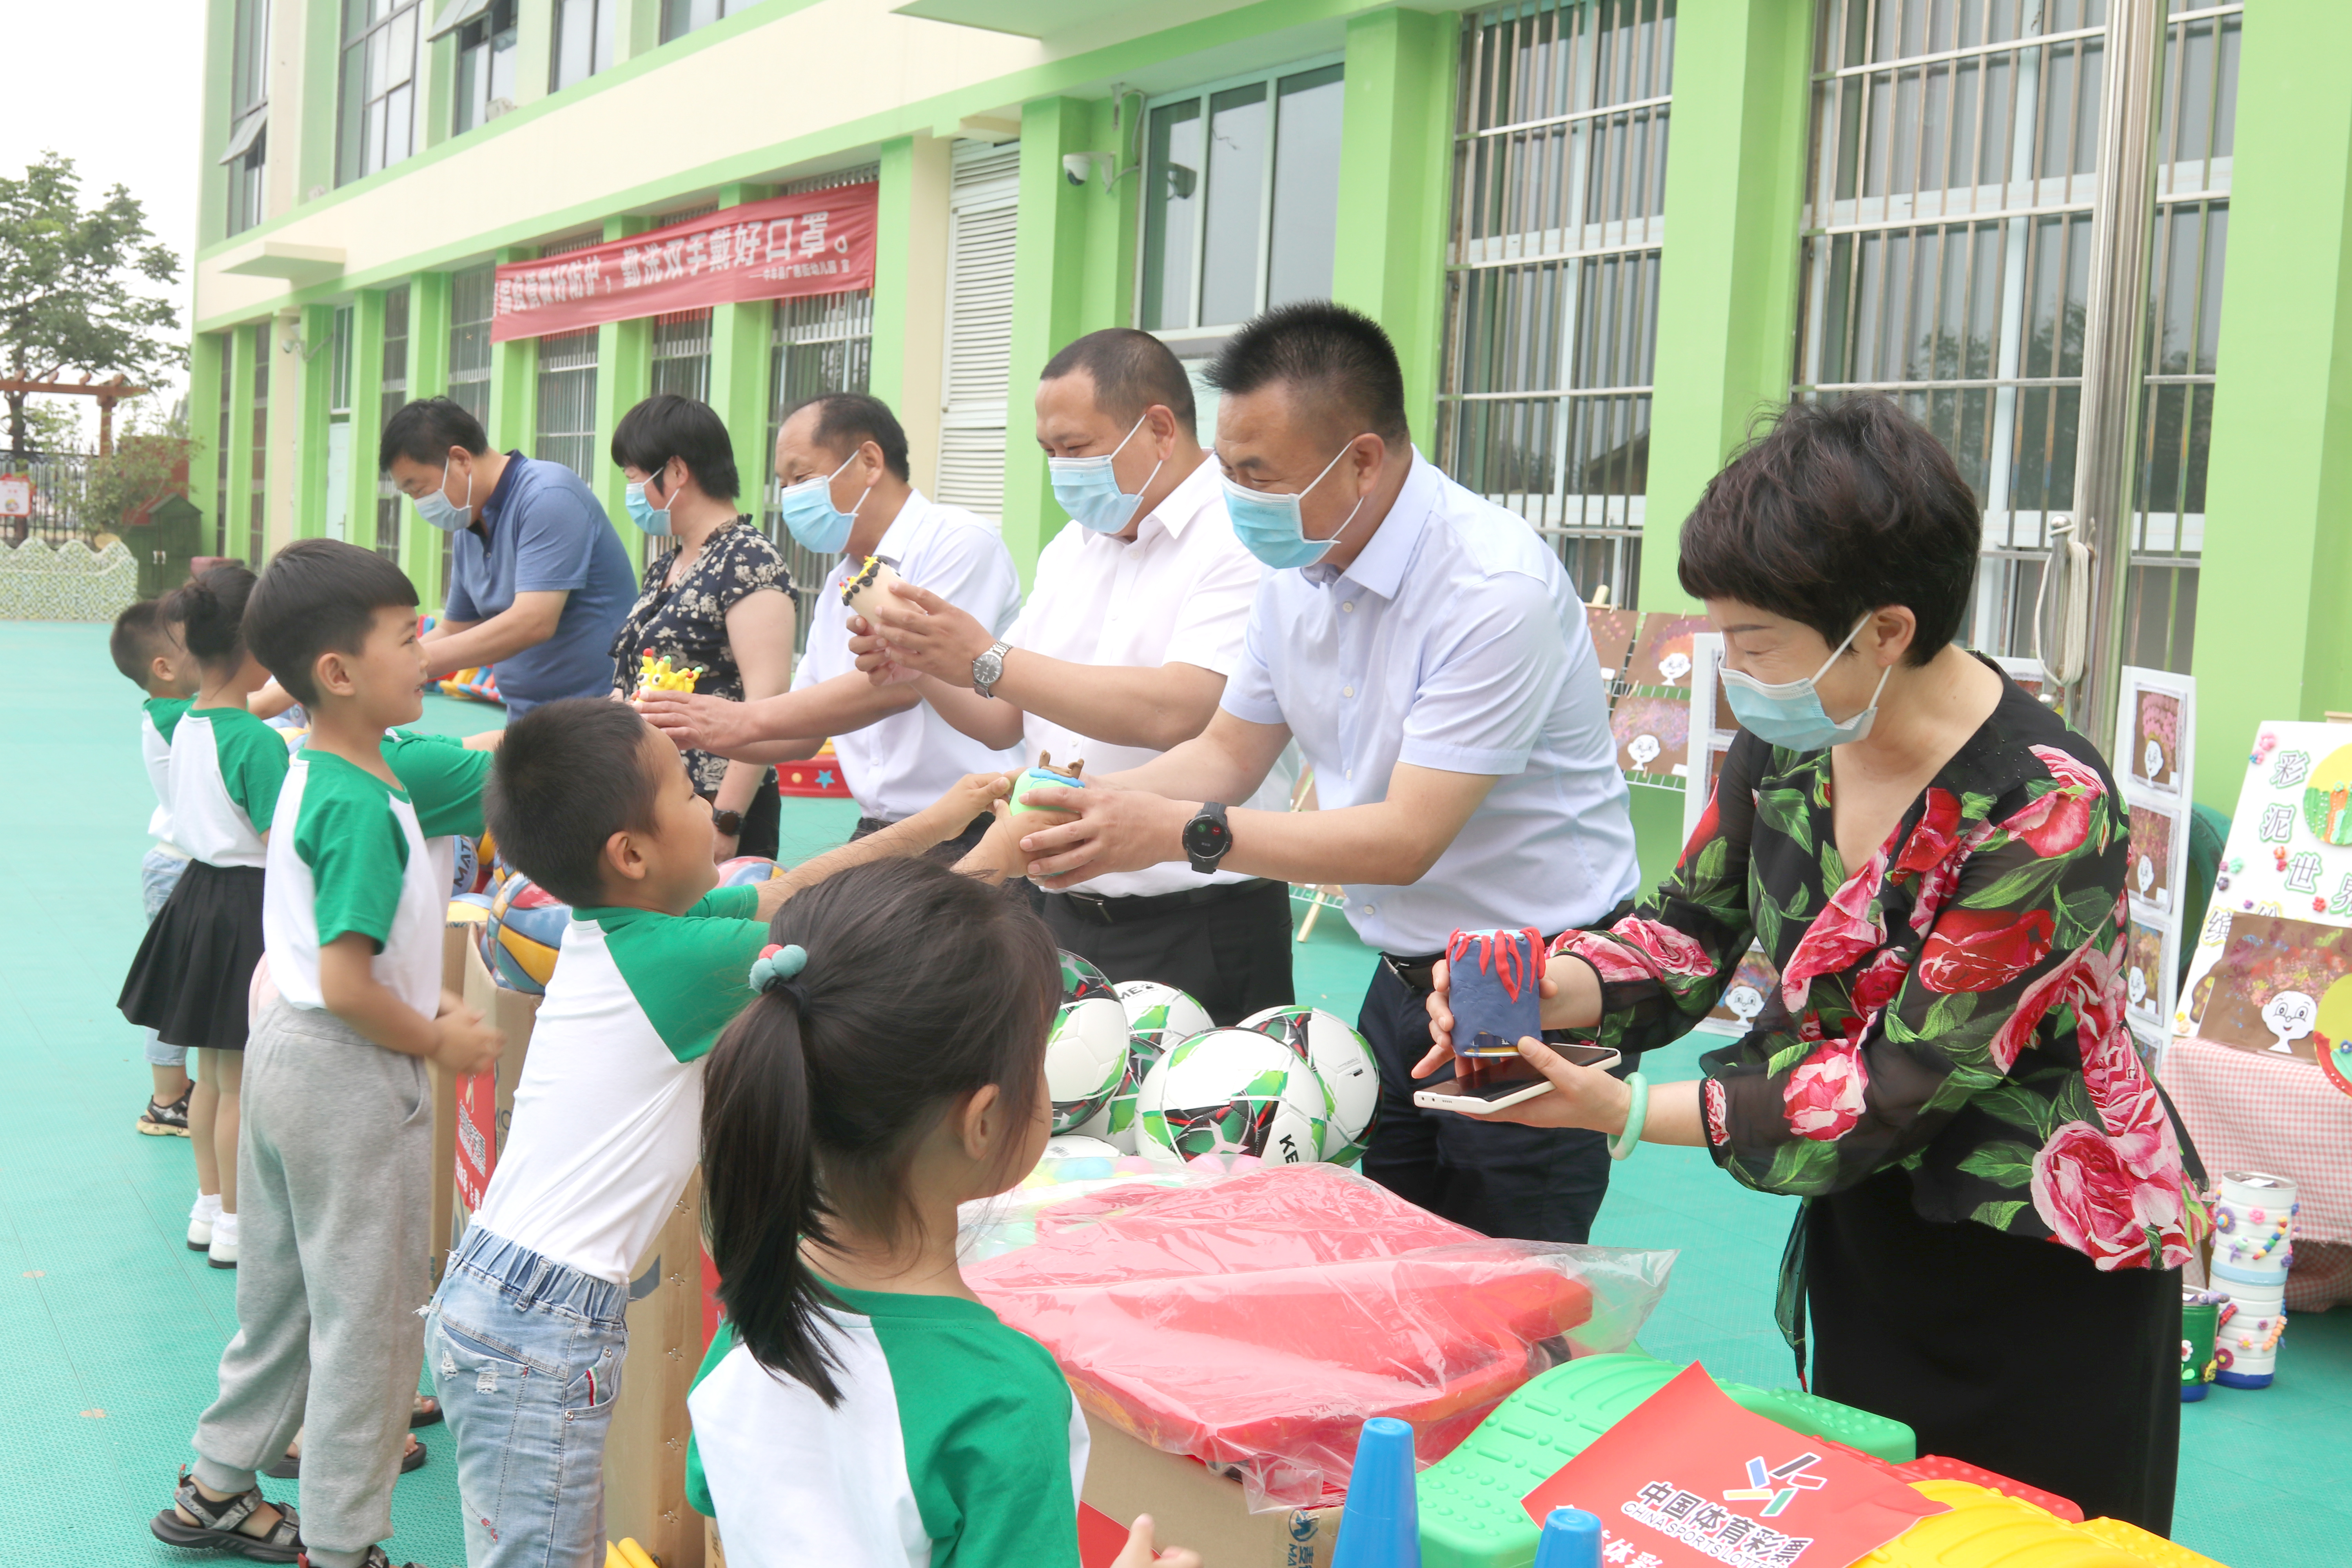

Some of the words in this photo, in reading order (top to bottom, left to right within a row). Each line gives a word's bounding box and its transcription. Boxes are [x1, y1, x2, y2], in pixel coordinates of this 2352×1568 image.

[1624, 1503, 1664, 1528] CHINA
[1666, 1523, 1722, 1556] SPORTS
[1640, 1483, 1811, 1564] 中国体育彩票
[1299, 1546, 1314, 1568] 麦
